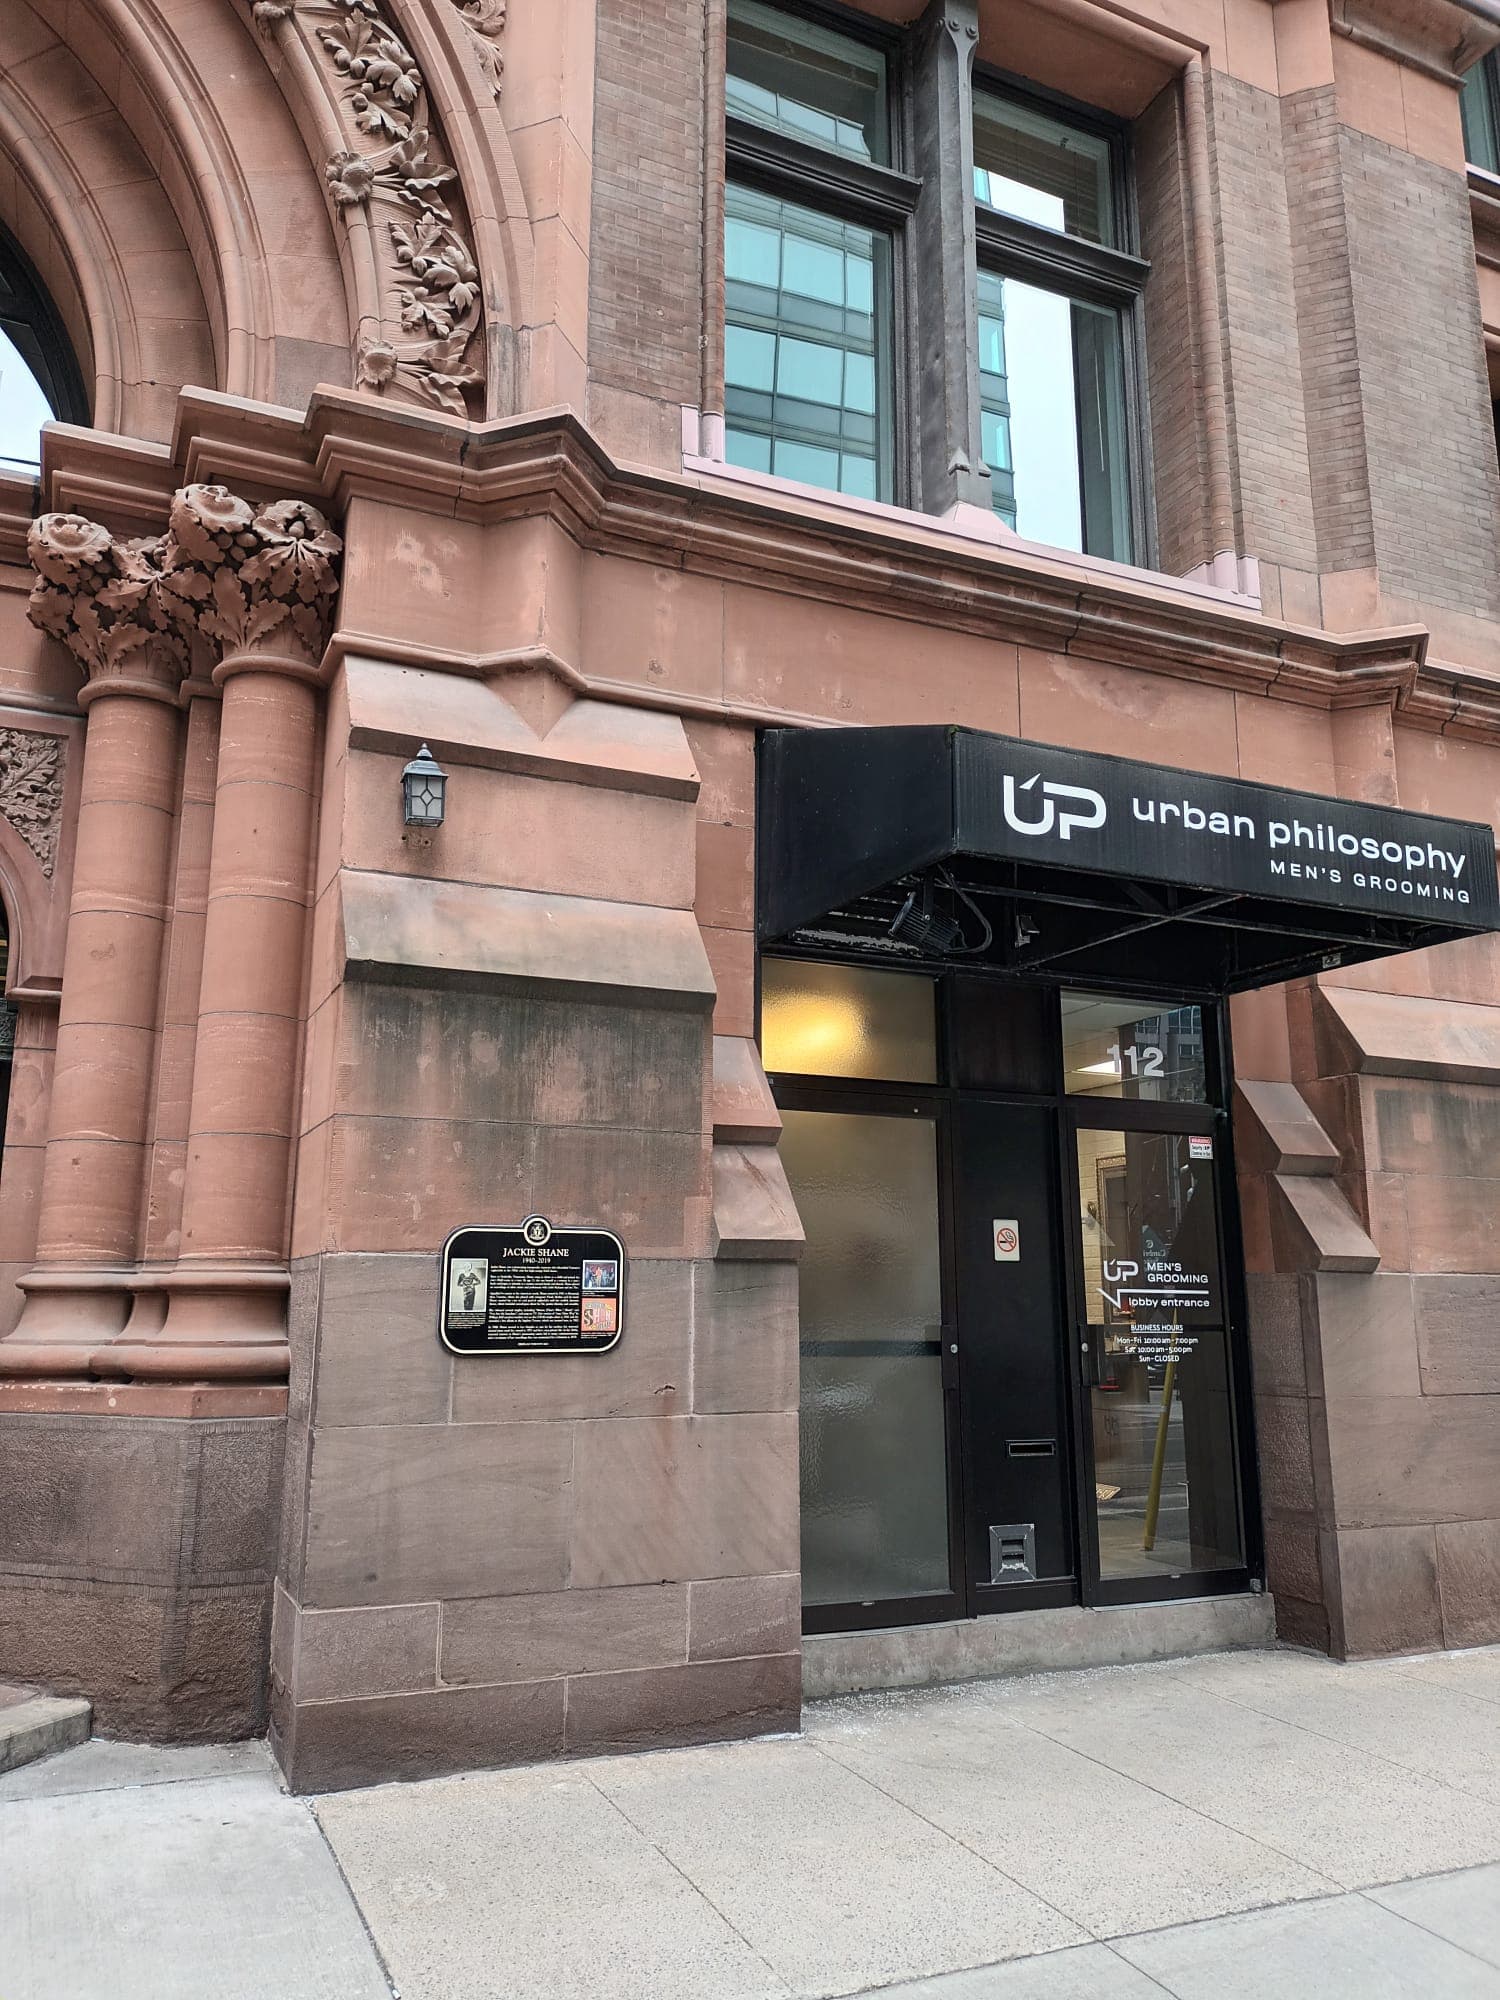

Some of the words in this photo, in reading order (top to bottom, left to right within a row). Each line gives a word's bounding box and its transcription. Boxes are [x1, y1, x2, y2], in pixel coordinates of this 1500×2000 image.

[1132, 797, 1256, 839] urban
[1268, 819, 1466, 878] philosophy
[1270, 858, 1342, 884] MEN'S
[1353, 872, 1471, 904] GROOMING
[1106, 1044, 1165, 1077] 112
[502, 1247, 536, 1258] JACKIE
[537, 1248, 570, 1257] SHANE
[1147, 1262, 1182, 1272] MEN'S
[1147, 1273, 1209, 1284] GROOMING
[1128, 1297, 1159, 1308] lobby
[1160, 1298, 1210, 1307] entrance
